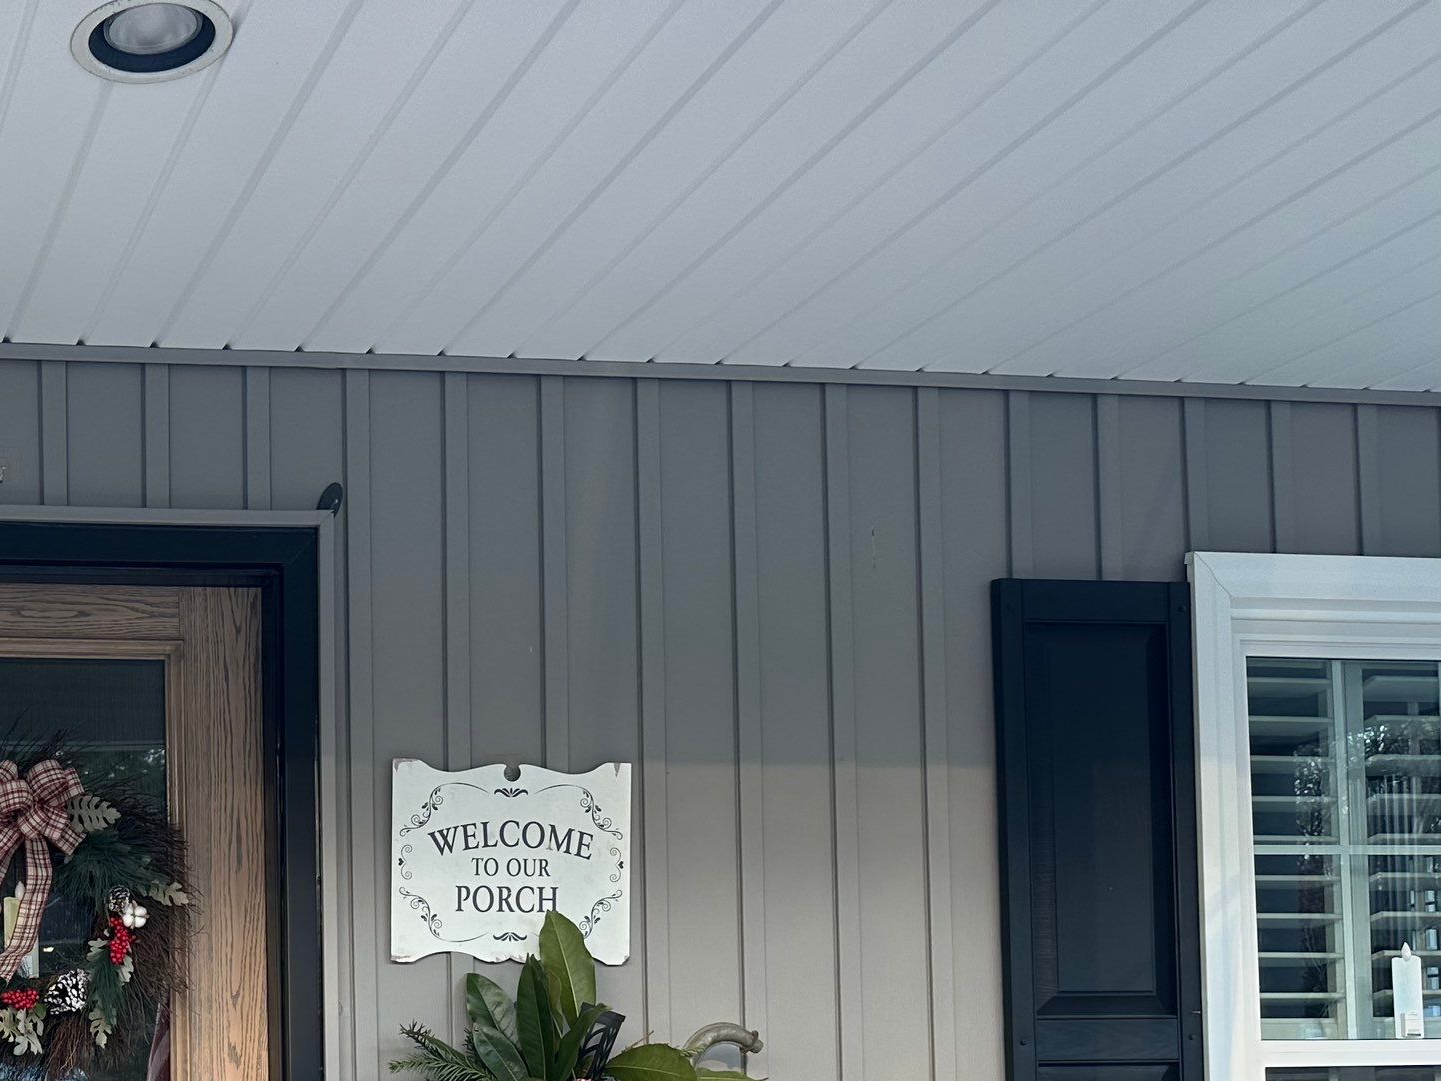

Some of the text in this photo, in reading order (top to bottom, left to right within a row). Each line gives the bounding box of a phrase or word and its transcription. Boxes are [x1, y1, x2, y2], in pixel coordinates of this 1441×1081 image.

[427, 819, 594, 861] WELCOME
[471, 857, 551, 878] TO OUR
[455, 885, 559, 913] PORCH
